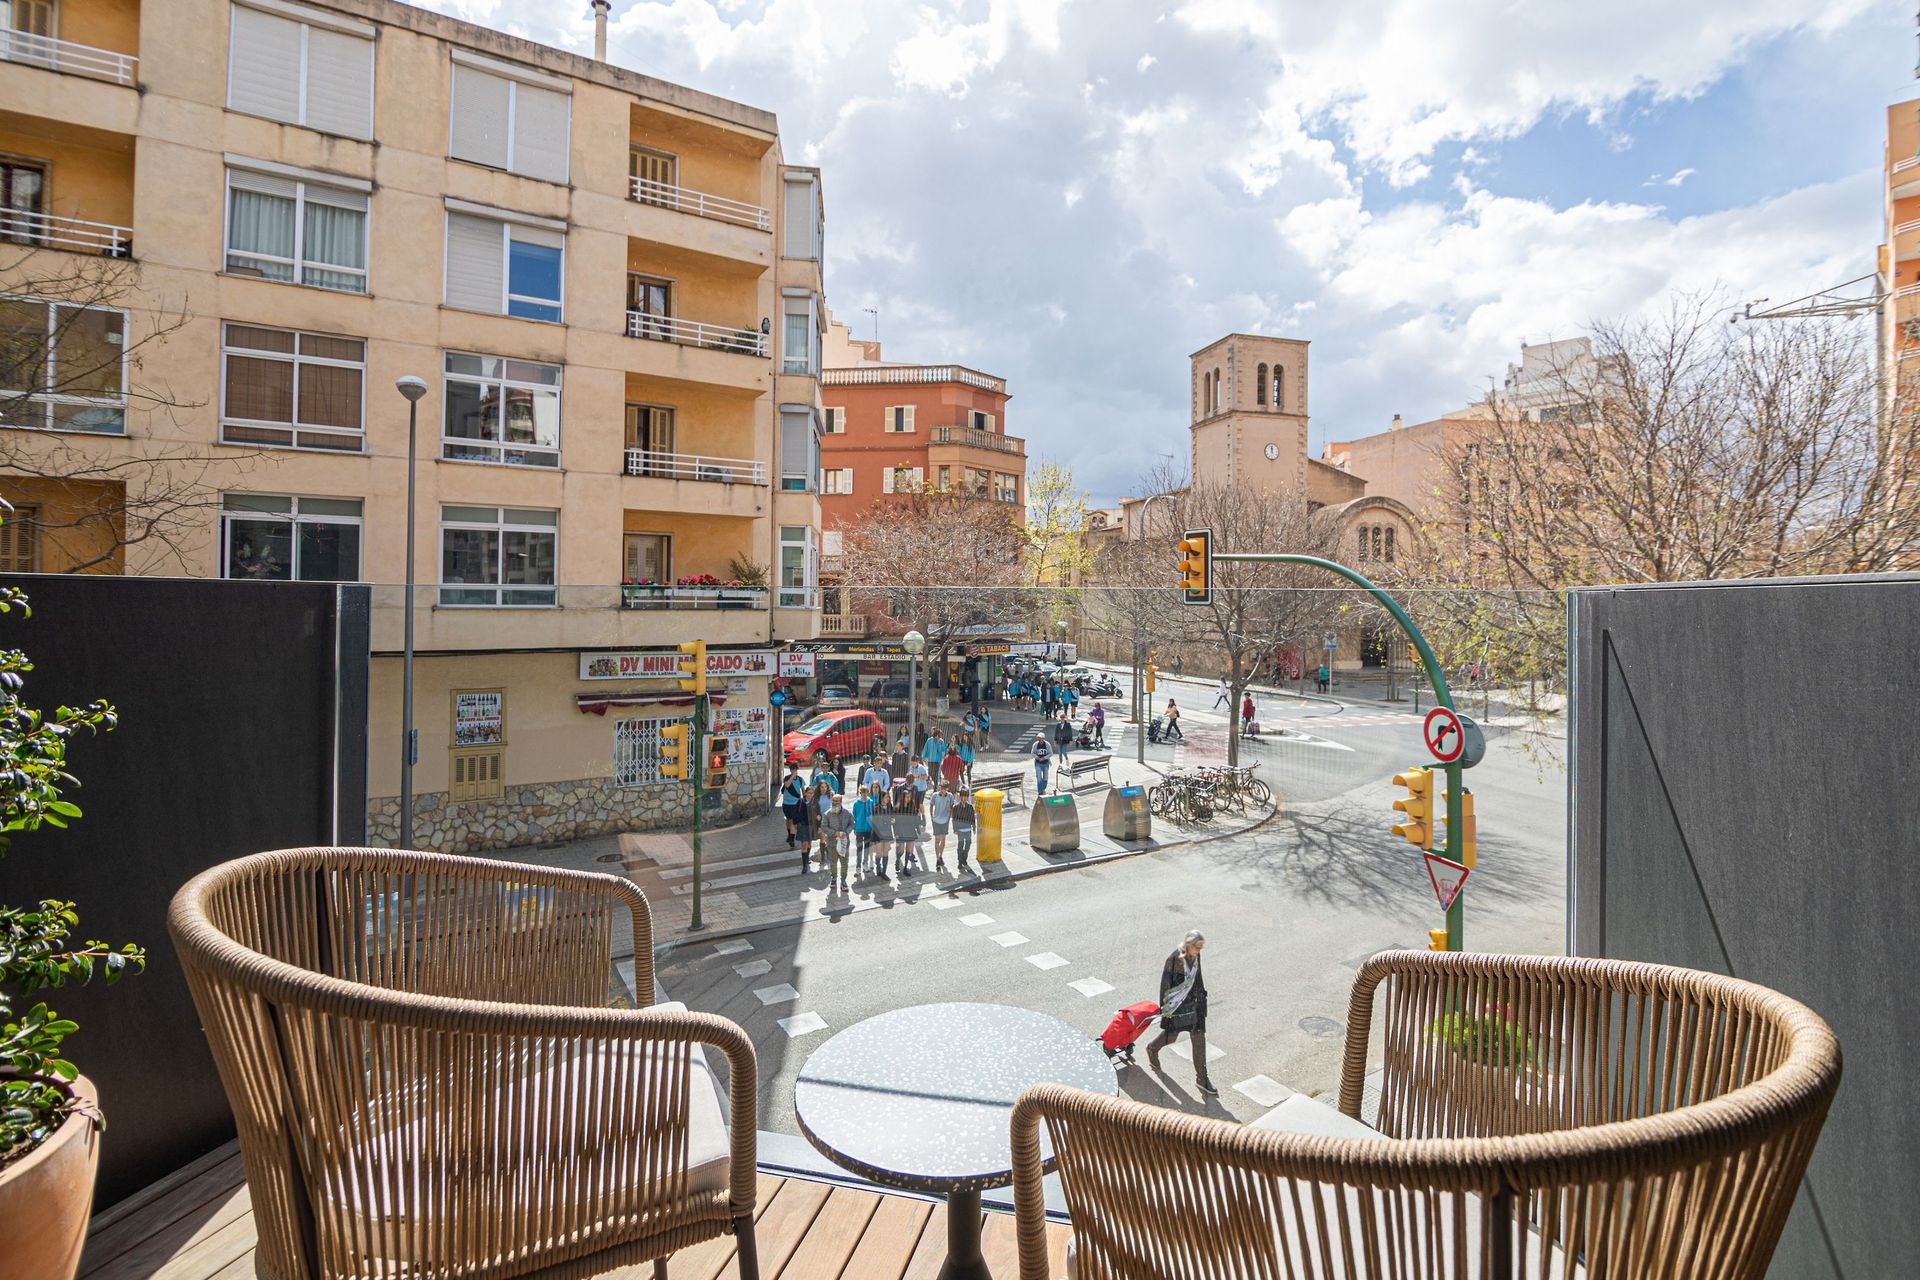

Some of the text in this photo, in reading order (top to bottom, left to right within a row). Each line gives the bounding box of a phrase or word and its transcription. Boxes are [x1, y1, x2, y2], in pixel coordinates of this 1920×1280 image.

[794, 644, 808, 653] Bar
[986, 645, 1009, 654] TABACS
[789, 654, 803, 662] DV
[620, 655, 742, 672] DV MINI CADO
